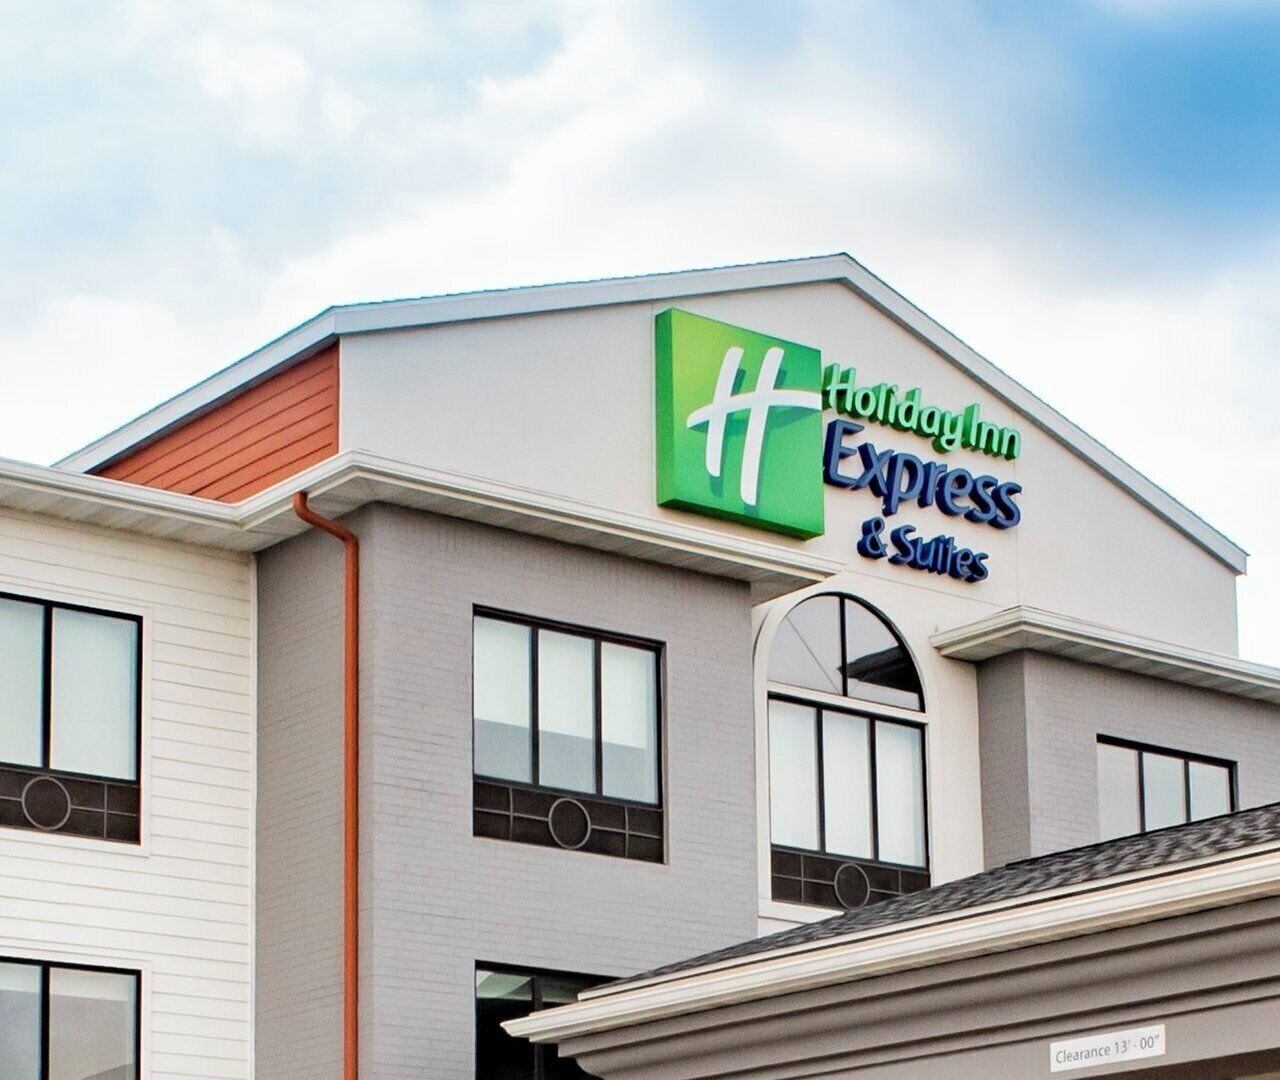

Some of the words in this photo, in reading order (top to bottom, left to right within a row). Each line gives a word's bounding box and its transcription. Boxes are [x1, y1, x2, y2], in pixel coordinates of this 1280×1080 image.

[822, 362, 963, 455] Holiday
[962, 403, 1021, 461] Inn
[823, 419, 1022, 529] Express
[857, 516, 888, 559] &
[888, 525, 989, 582] Suites
[1055, 1046, 1111, 1064] Clearance
[1114, 1039, 1131, 1055] 13'
